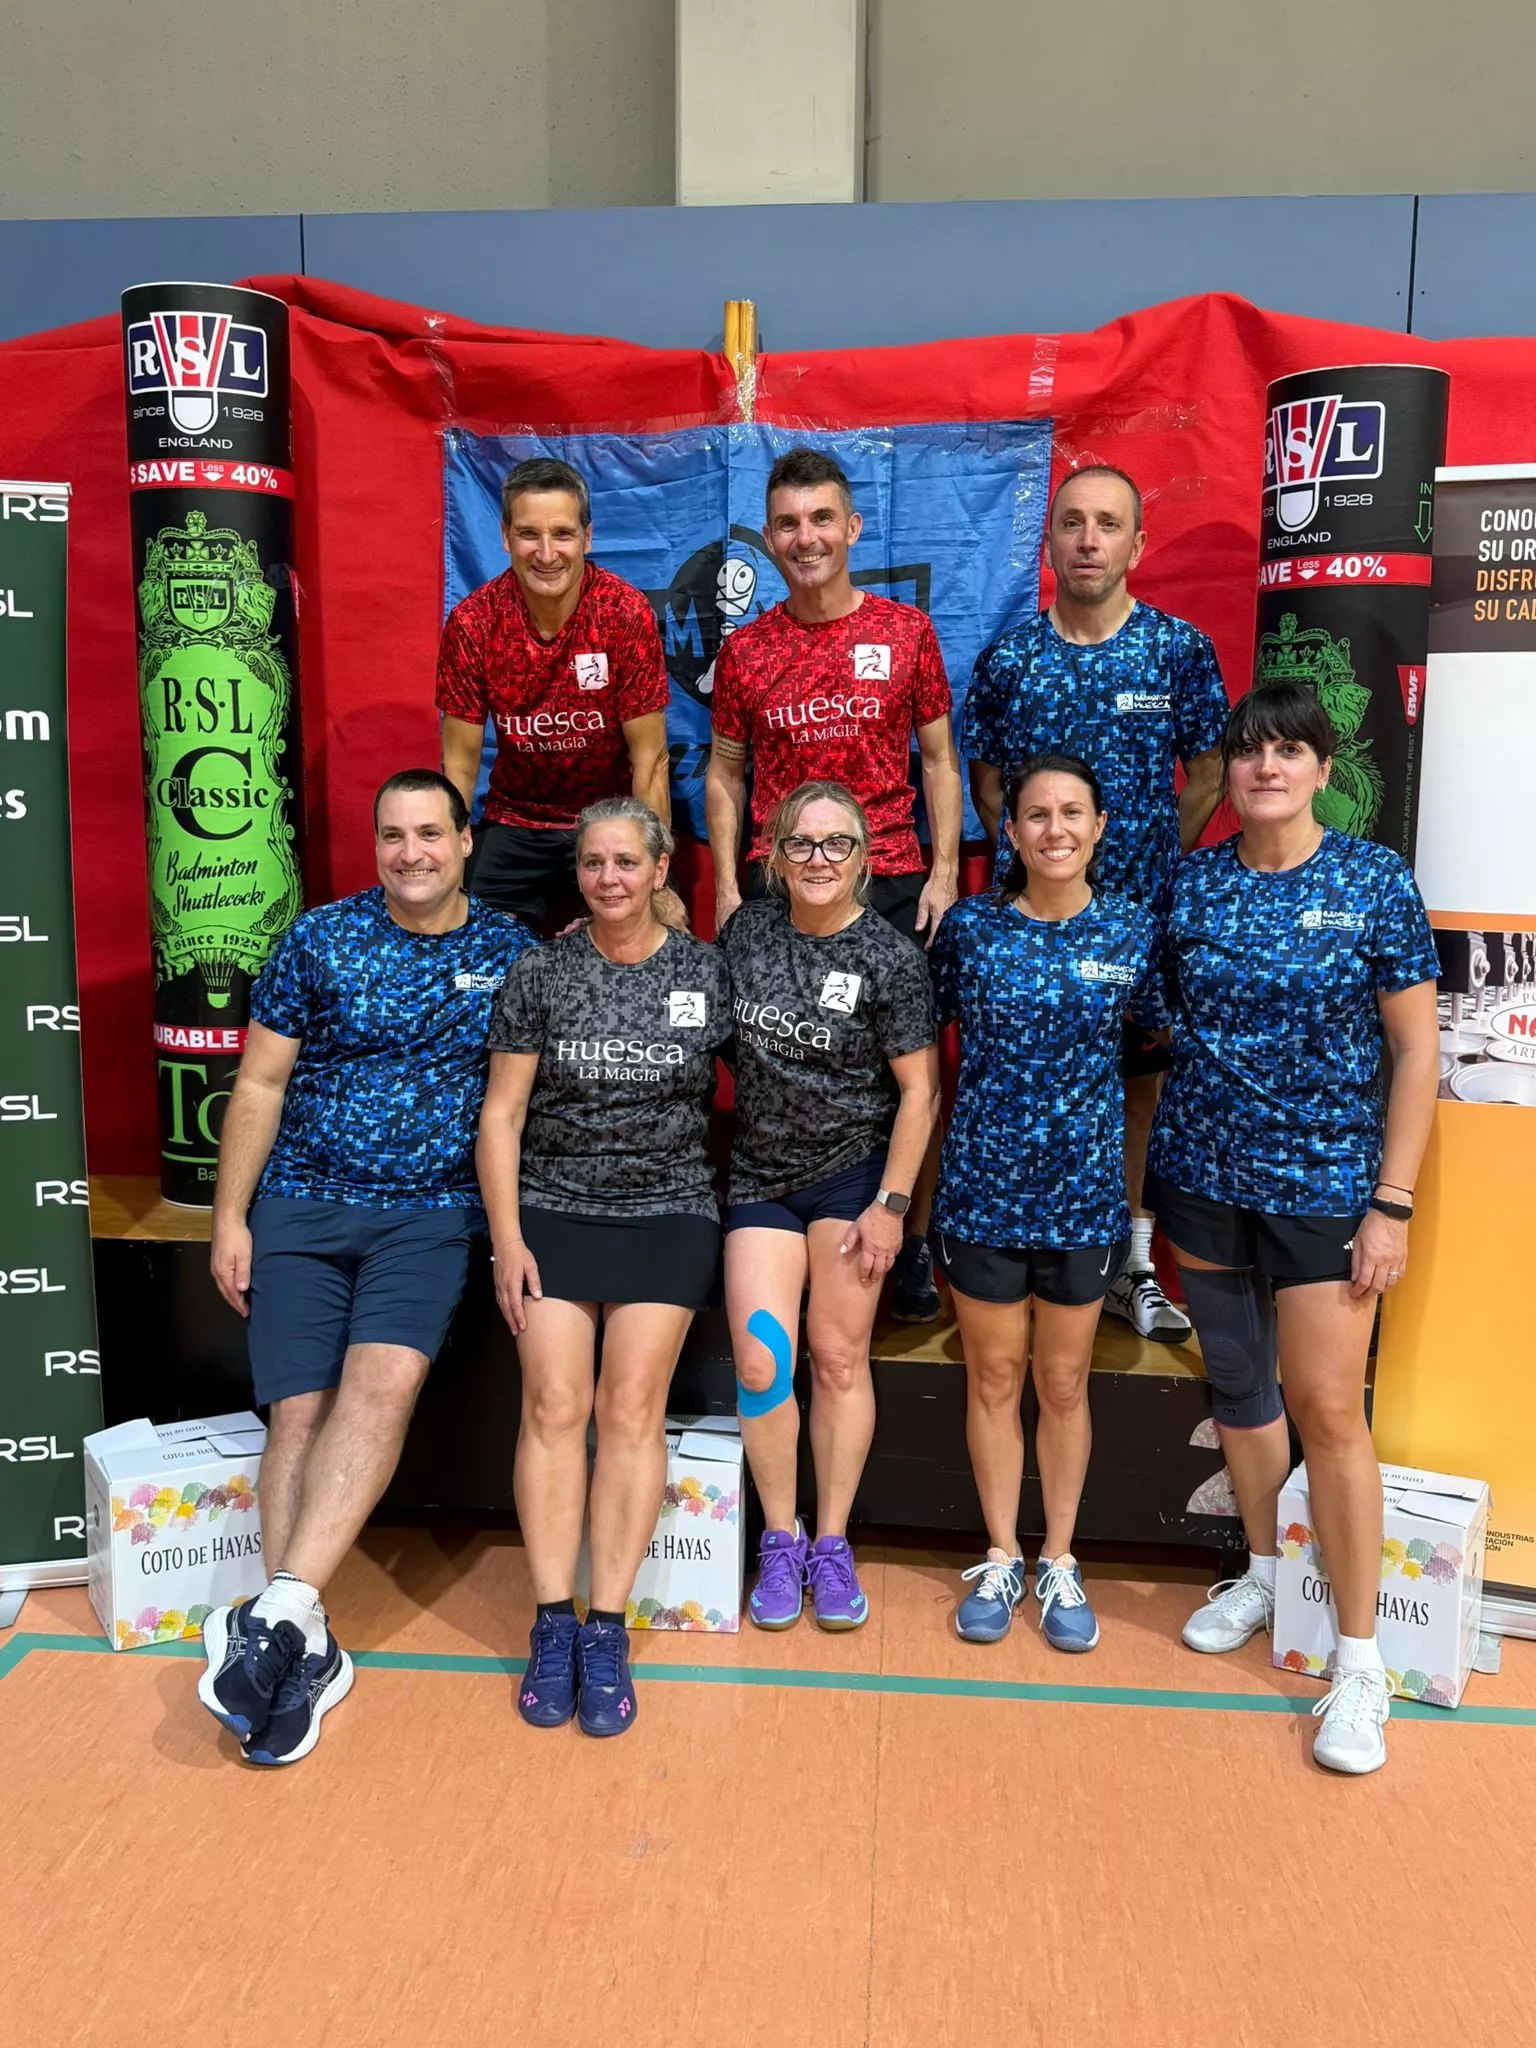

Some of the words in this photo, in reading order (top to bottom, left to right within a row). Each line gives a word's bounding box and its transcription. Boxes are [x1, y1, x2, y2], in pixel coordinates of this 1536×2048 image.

[133, 406, 166, 420] since
[222, 406, 265, 422] 1928
[158, 437, 233, 449] ENGLAND
[137, 462, 196, 484] SAVE
[201, 463, 225, 473] Less
[230, 464, 278, 489] 40%
[1323, 493, 1374, 508] 1928
[1480, 508, 1536, 533] CONO
[1267, 531, 1332, 550] ENGLAND
[1478, 540, 1504, 562] SU
[1325, 555, 1387, 579] 40%
[1476, 568, 1536, 592] DISFR
[1473, 599, 1500, 622] SU
[1407, 669, 1418, 718] BWF
[156, 776, 270, 809] Classic
[166, 850, 258, 887] Badminton
[172, 881, 266, 918] Shuttlecocks
[174, 934, 215, 951] since
[223, 934, 262, 951] 1928
[141, 1547, 183, 1575] COTO
[188, 1545, 209, 1567] DE
[212, 1532, 261, 1562] HAYAS
[664, 1535, 711, 1561] HAYAS
[1302, 1575, 1331, 1606] COT
[1375, 1591, 1430, 1627] HAYAS
